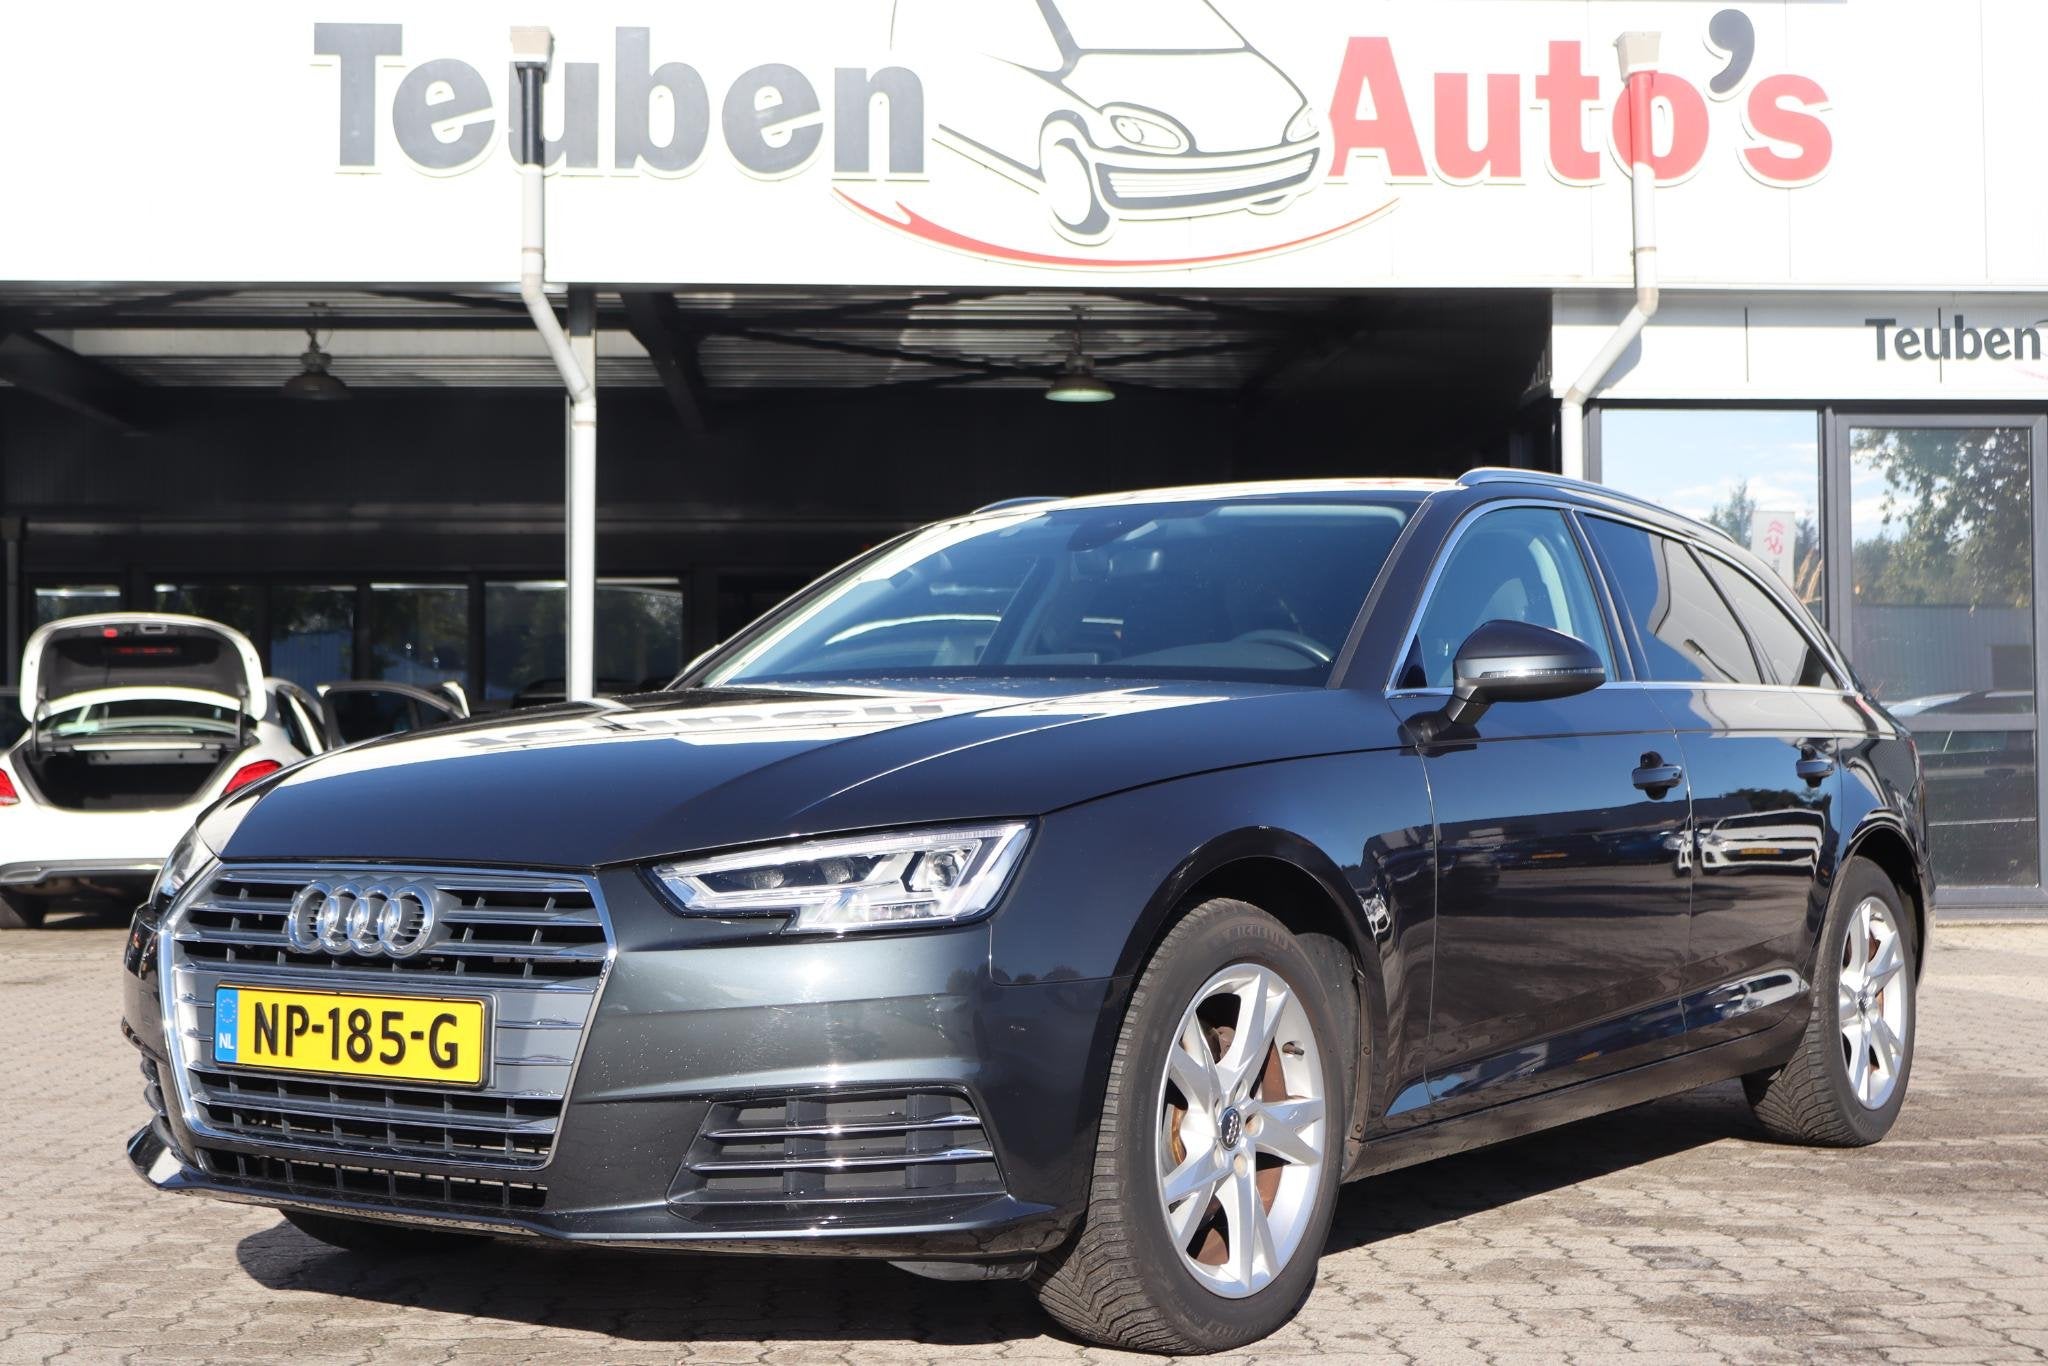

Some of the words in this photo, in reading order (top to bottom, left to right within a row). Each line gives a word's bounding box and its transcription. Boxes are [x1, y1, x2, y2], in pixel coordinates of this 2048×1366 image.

[314, 22, 925, 178] Teuben
[1327, 8, 1834, 181] Auto's
[1864, 314, 2041, 361] Teuben
[218, 1032, 235, 1050] NL
[253, 1001, 459, 1069] NP-185-G
